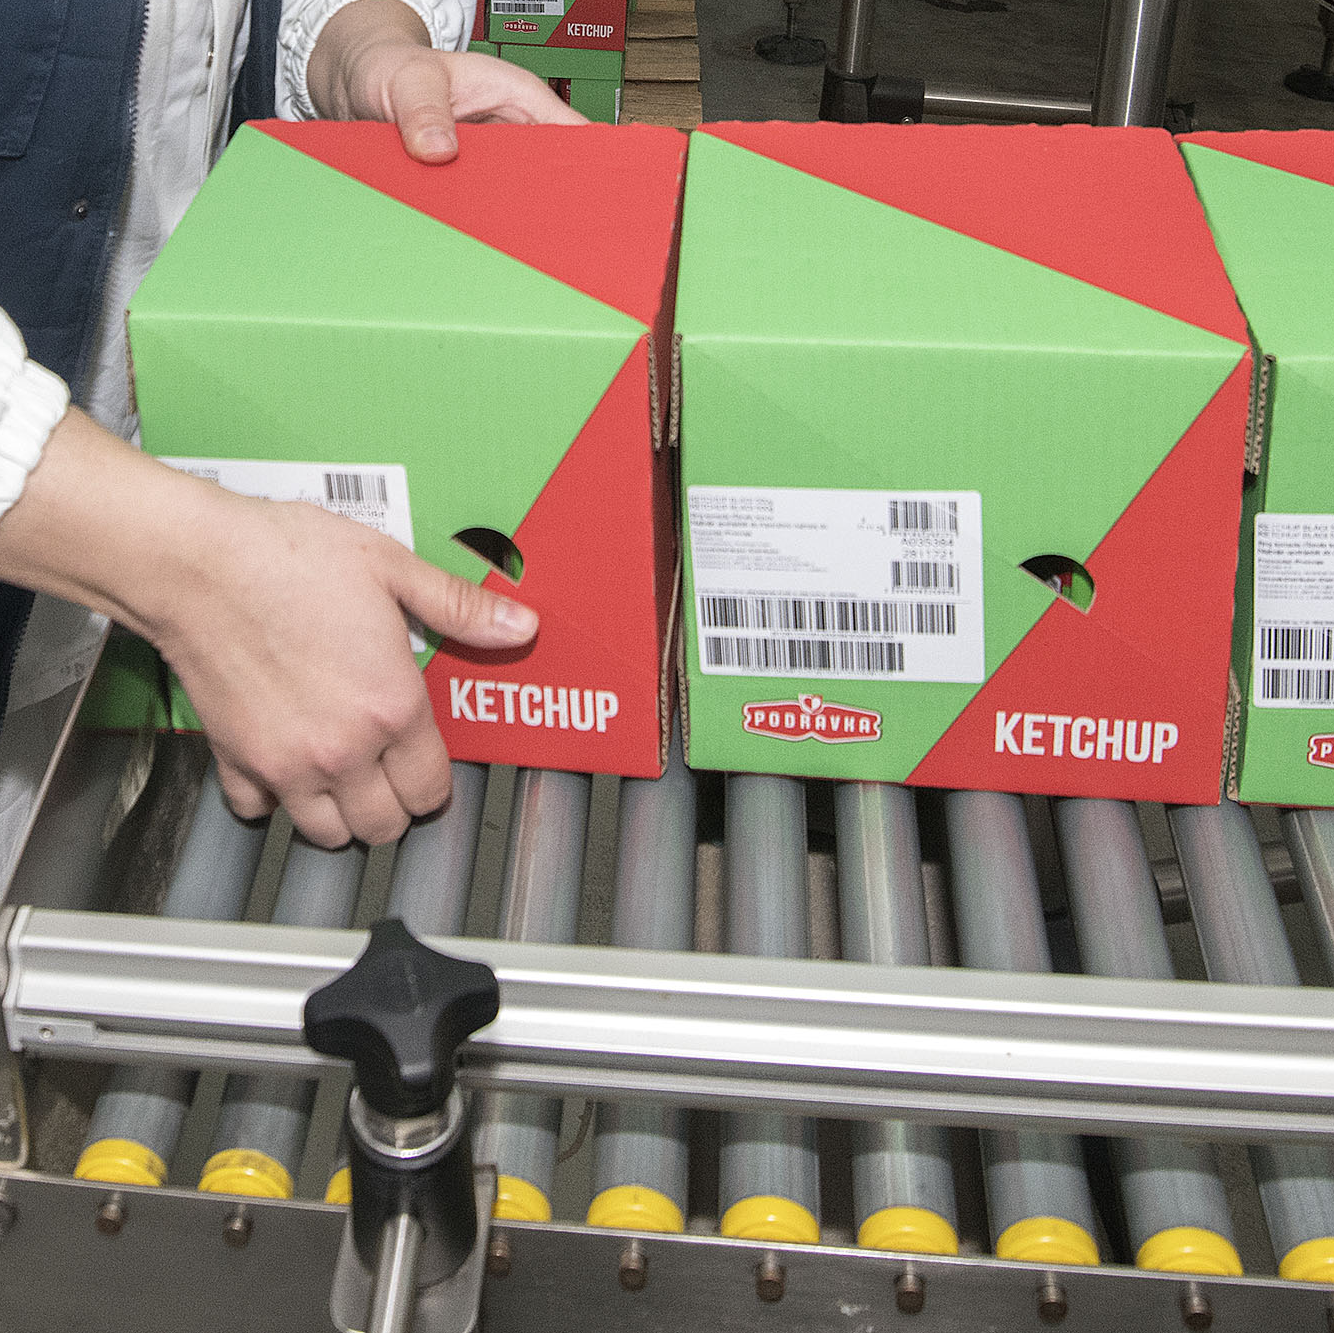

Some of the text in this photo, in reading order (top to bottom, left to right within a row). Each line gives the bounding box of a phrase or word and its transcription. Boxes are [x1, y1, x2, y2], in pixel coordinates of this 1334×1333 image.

[567, 23, 614, 38] KETCHUP
[449, 677, 620, 732] KETCHUP
[753, 709, 871, 734] PODRAVKA
[994, 711, 1179, 764] KETCHUP
